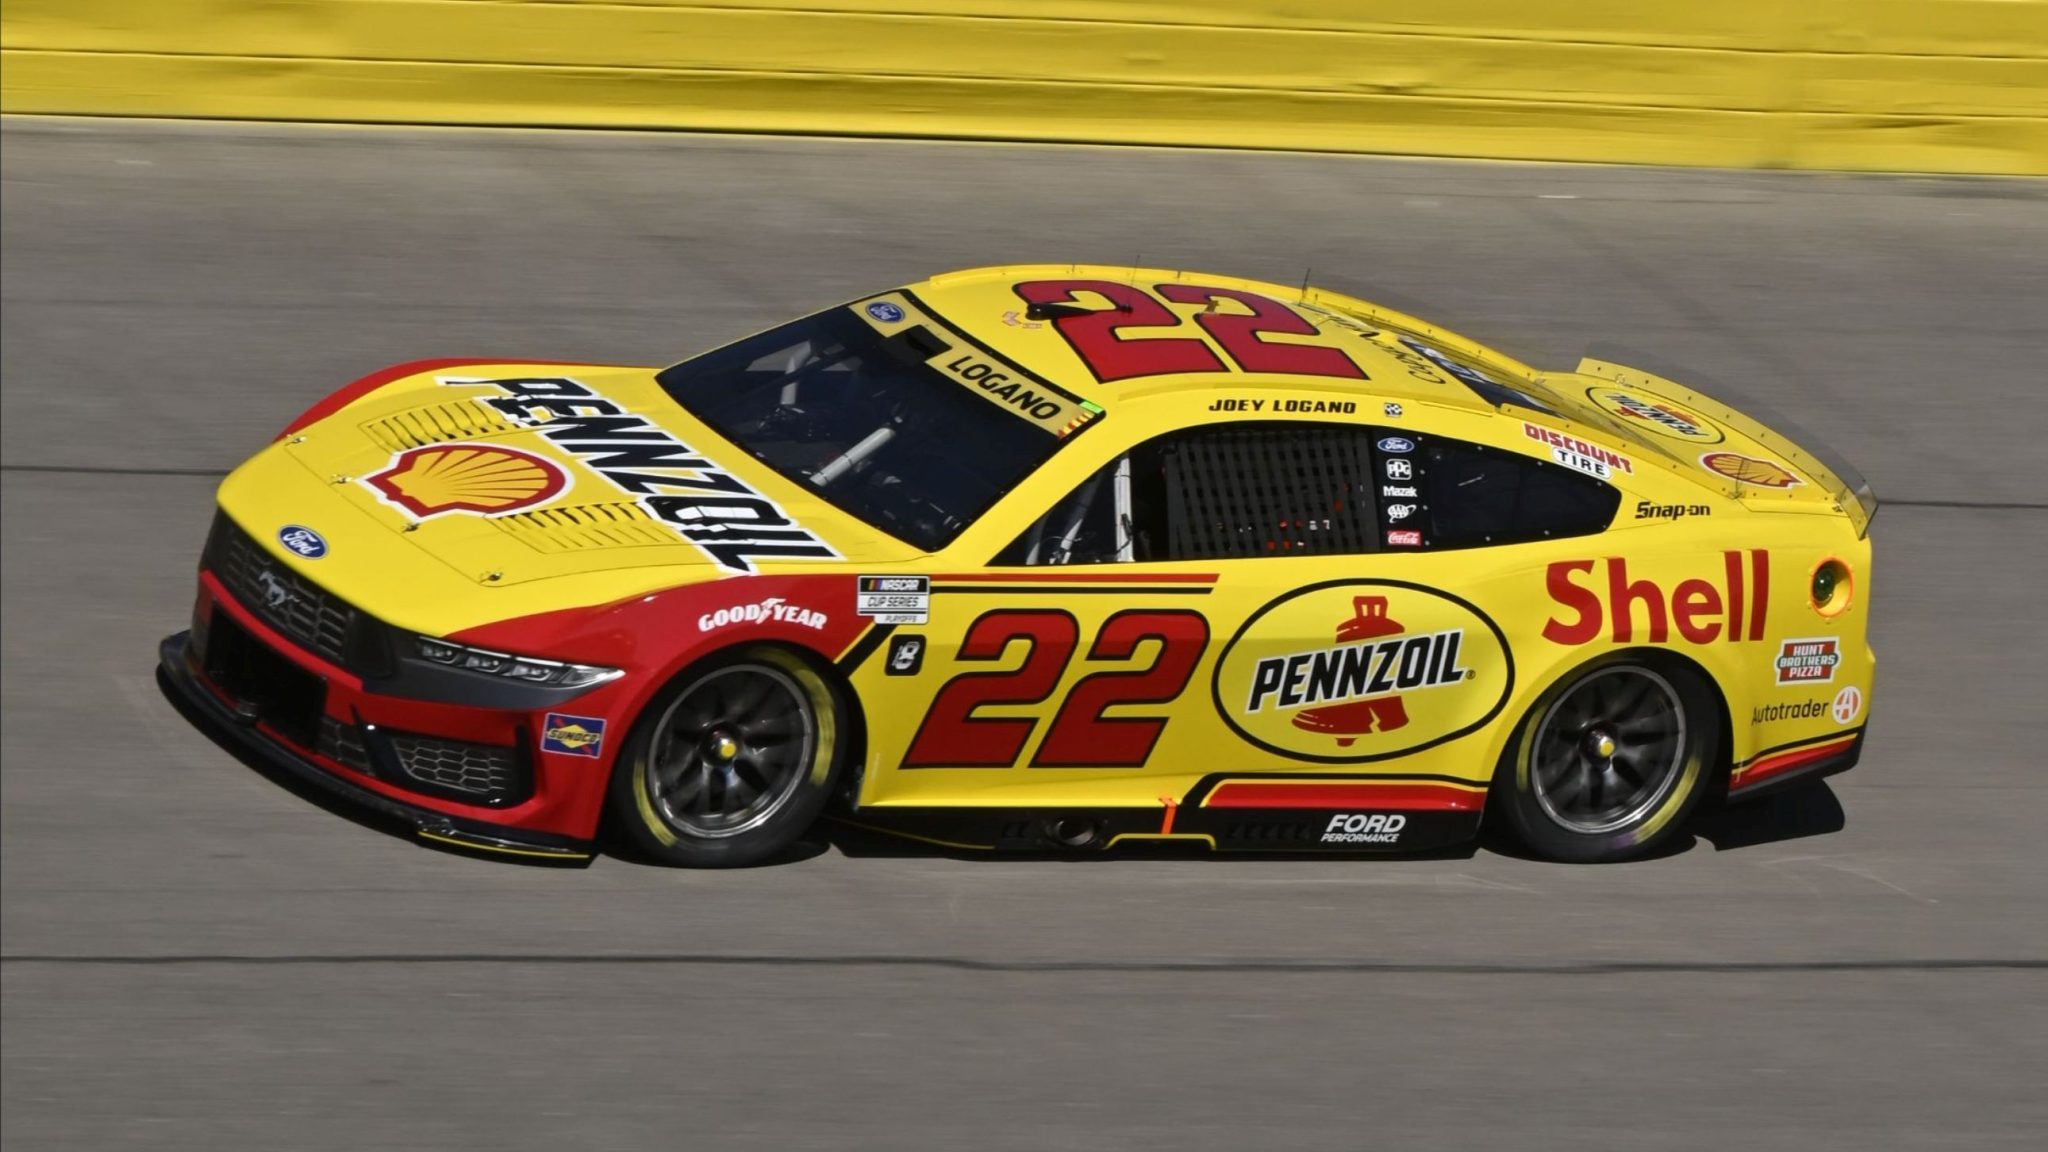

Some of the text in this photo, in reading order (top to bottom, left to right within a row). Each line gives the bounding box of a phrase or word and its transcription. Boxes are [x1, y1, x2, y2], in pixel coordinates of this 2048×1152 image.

[1012, 280, 1371, 383] 22
[947, 356, 1062, 420] LOGANO
[1208, 400, 1357, 414] JOEY LOGANO
[1524, 423, 1632, 473] DISCOUNT
[1388, 461, 1410, 477] PPG
[1558, 450, 1605, 475] TIRE
[434, 373, 848, 574] PENNZOIL
[1383, 485, 1417, 497] Mazak
[1635, 502, 1711, 520] Snap-on
[283, 531, 319, 554] Ford
[881, 579, 919, 590] NASCAR
[868, 597, 919, 607] CUP SERIES
[1542, 548, 1769, 646] Shell
[698, 597, 827, 632] GOODYEAR
[1793, 645, 1825, 656] HUNT
[1780, 655, 1835, 667] BROTHERS
[1247, 630, 1465, 713] PENNZOIL
[1789, 666, 1822, 678] PIZZA
[898, 608, 1211, 769] 22
[1752, 698, 1829, 725] Autotrader
[549, 729, 600, 743] SUNOCO
[1326, 815, 1406, 832] FORD
[1321, 834, 1399, 842] PERFORMANCE
